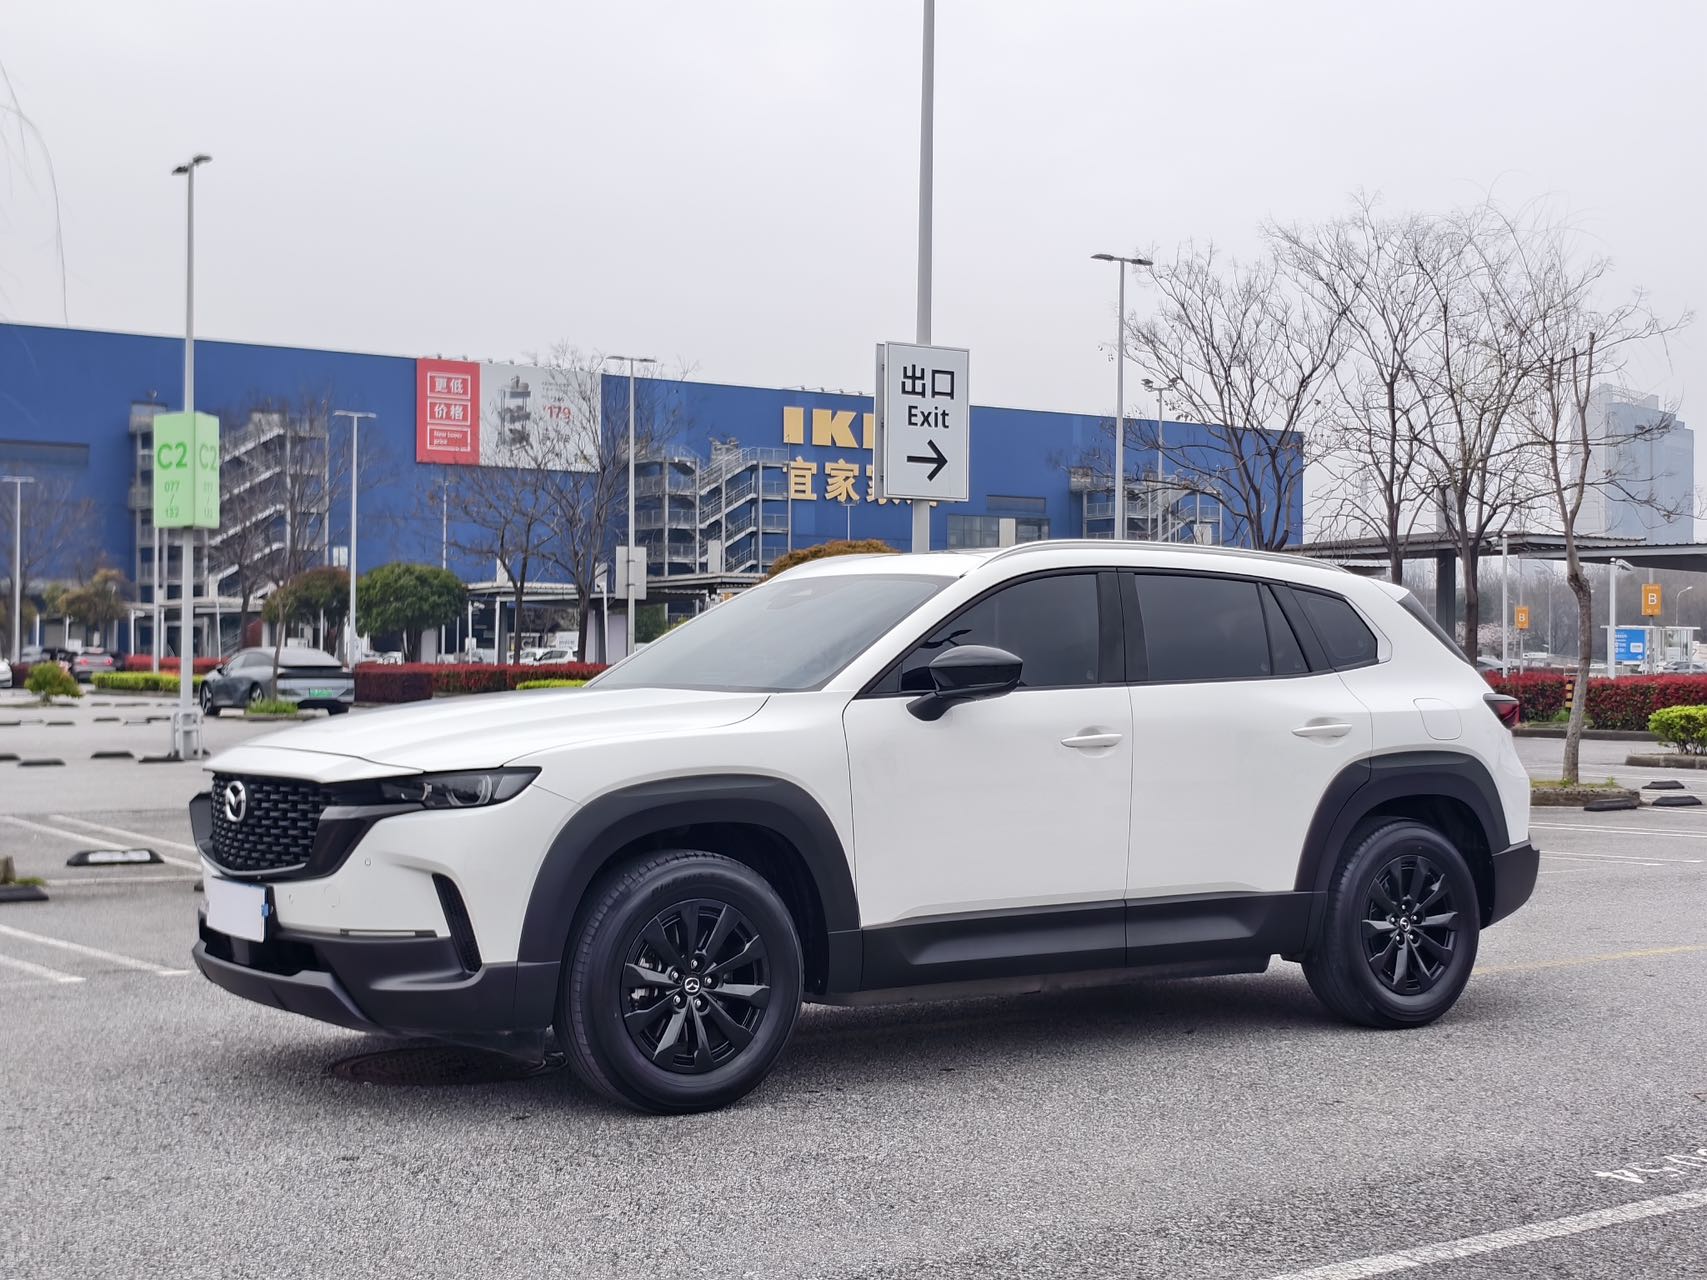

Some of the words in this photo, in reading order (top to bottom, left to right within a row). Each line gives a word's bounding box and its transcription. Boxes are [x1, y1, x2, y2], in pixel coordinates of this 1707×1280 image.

[901, 364, 954, 400] 出口
[434, 403, 464, 420] 价格
[908, 405, 949, 428] Exit
[157, 442, 188, 470] C2
[199, 443, 217, 470] C2
[1648, 593, 1657, 605] B
[1518, 612, 1525, 621] B
